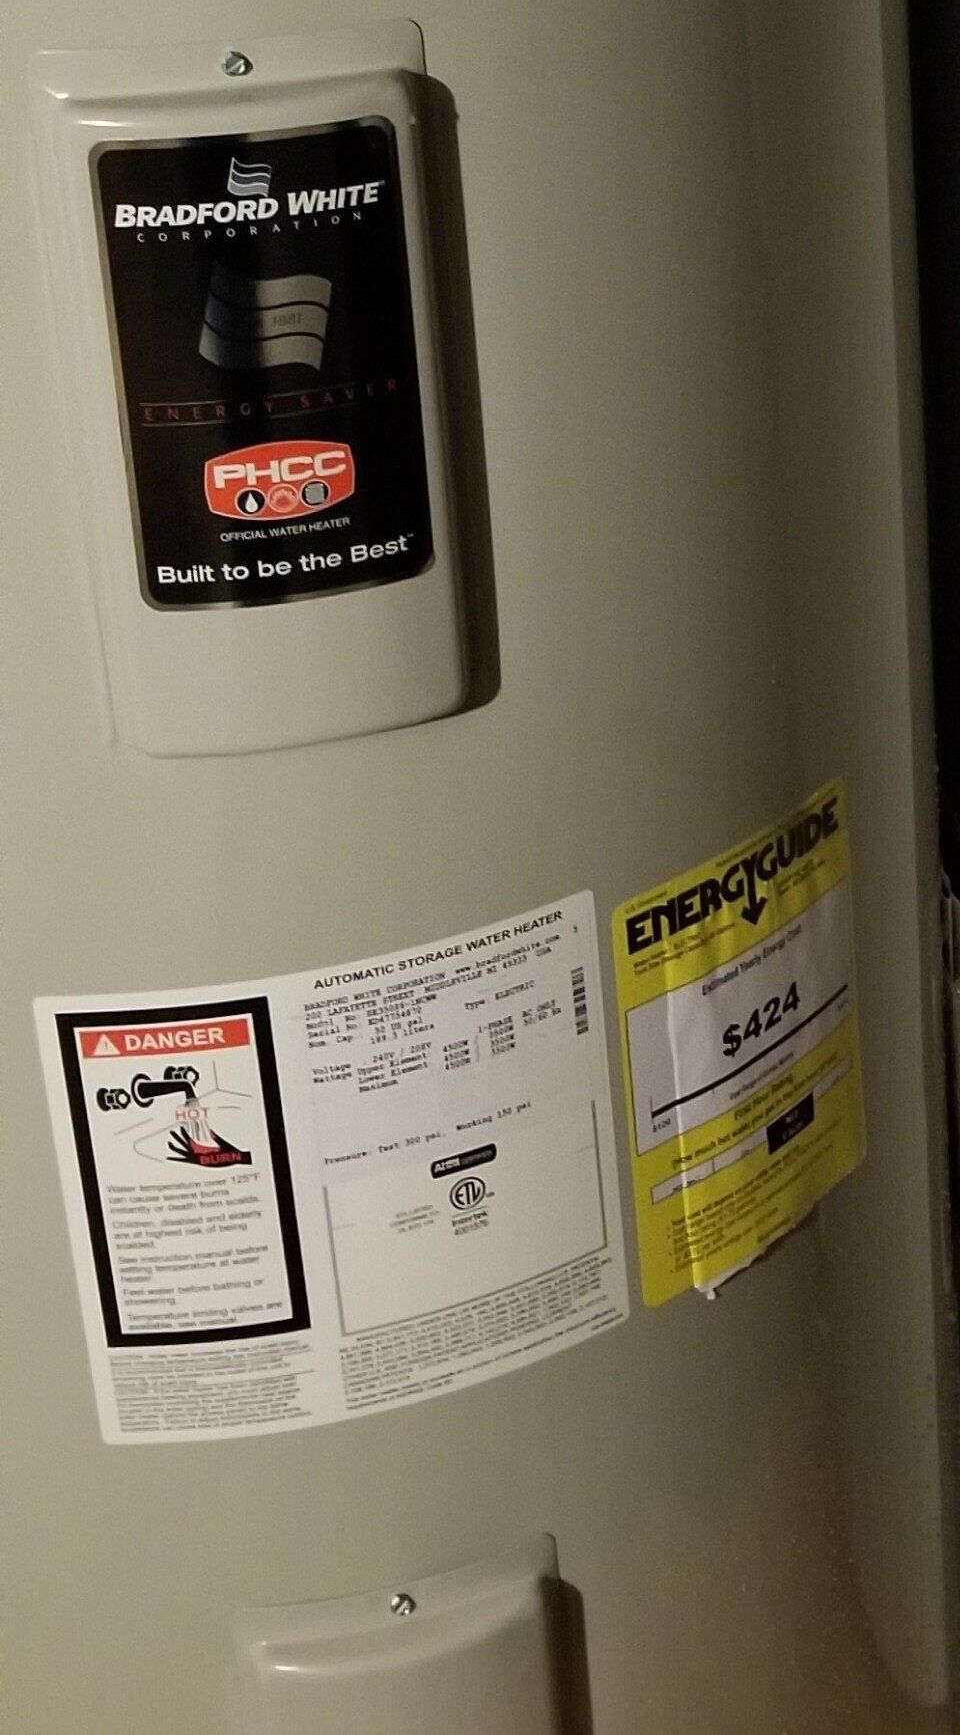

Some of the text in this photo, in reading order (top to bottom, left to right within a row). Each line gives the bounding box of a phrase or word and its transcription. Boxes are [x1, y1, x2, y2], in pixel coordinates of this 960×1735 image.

[114, 181, 381, 228] BRADFORD WHITE
[136, 211, 363, 243] CORPORATION
[144, 379, 398, 422] ENERGY SAVER
[213, 450, 347, 489] PHCC
[220, 517, 350, 543] OFFICIAL WATER HEATER
[157, 535, 408, 585] Built to be the Best
[626, 796, 839, 955] ENERGYGUIDE
[314, 910, 563, 990] AUTOMATIC STORAGE WATER HEATER
[702, 923, 801, 996] Estimated Yearly Energy Cost
[304, 996, 348, 1012] BRADFORD
[353, 989, 382, 1001] WHITE
[386, 972, 446, 994] CORPORATION
[722, 981, 800, 1057] $424
[124, 1026, 226, 1051] DANGER
[175, 1107, 209, 1121] HOT
[199, 1152, 242, 1165] BURN
[140, 1182, 201, 1192] temperature
[161, 1217, 202, 1226] disabled
[206, 1214, 225, 1222] and
[168, 1203, 196, 1211] death
[146, 1229, 182, 1239] highest
[219, 1223, 247, 1232] being
[141, 1254, 192, 1262] instruction
[196, 1250, 232, 1258] manual
[236, 1246, 268, 1255] before
[155, 1262, 215, 1272] temperature
[178, 1285, 210, 1294] before
[214, 1281, 250, 1290] bathing
